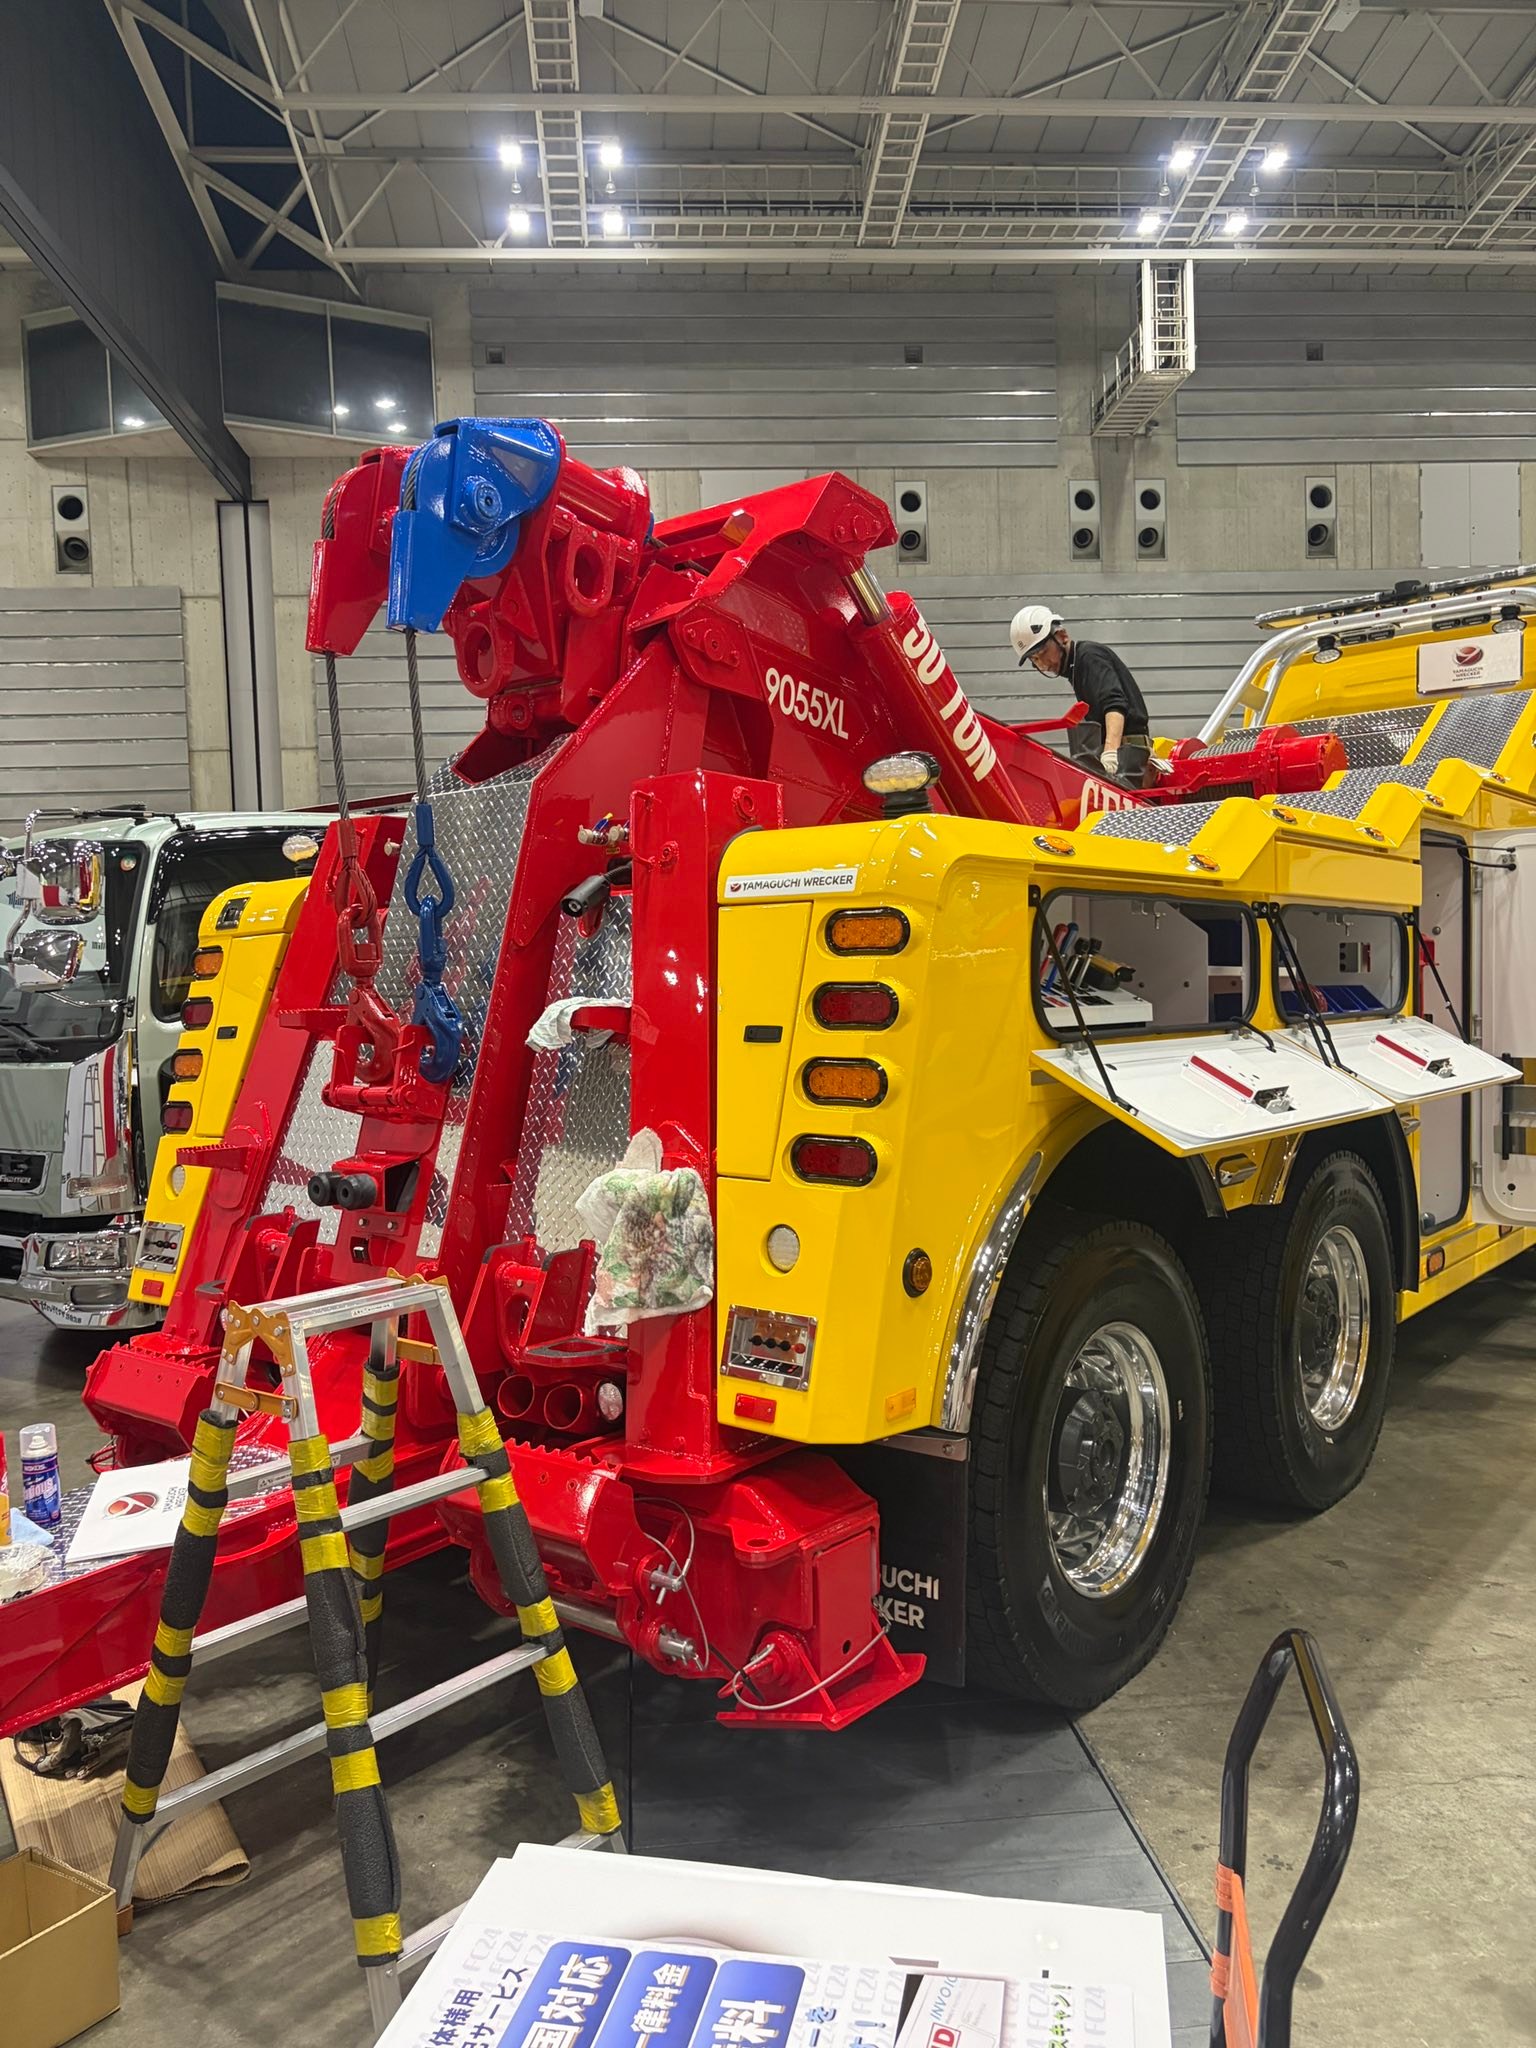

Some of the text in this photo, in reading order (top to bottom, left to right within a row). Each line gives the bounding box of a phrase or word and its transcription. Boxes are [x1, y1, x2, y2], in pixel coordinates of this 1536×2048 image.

[765, 667, 848, 740] 9055XL
[903, 613, 997, 782] 50 TON
[742, 874, 854, 892] YAMAGUCHI WRECKER
[426, 1989, 483, 2048] 体様用
[520, 1953, 612, 2048] 国対応
[710, 1999, 786, 2048] 料
[931, 2028, 956, 2048] D
